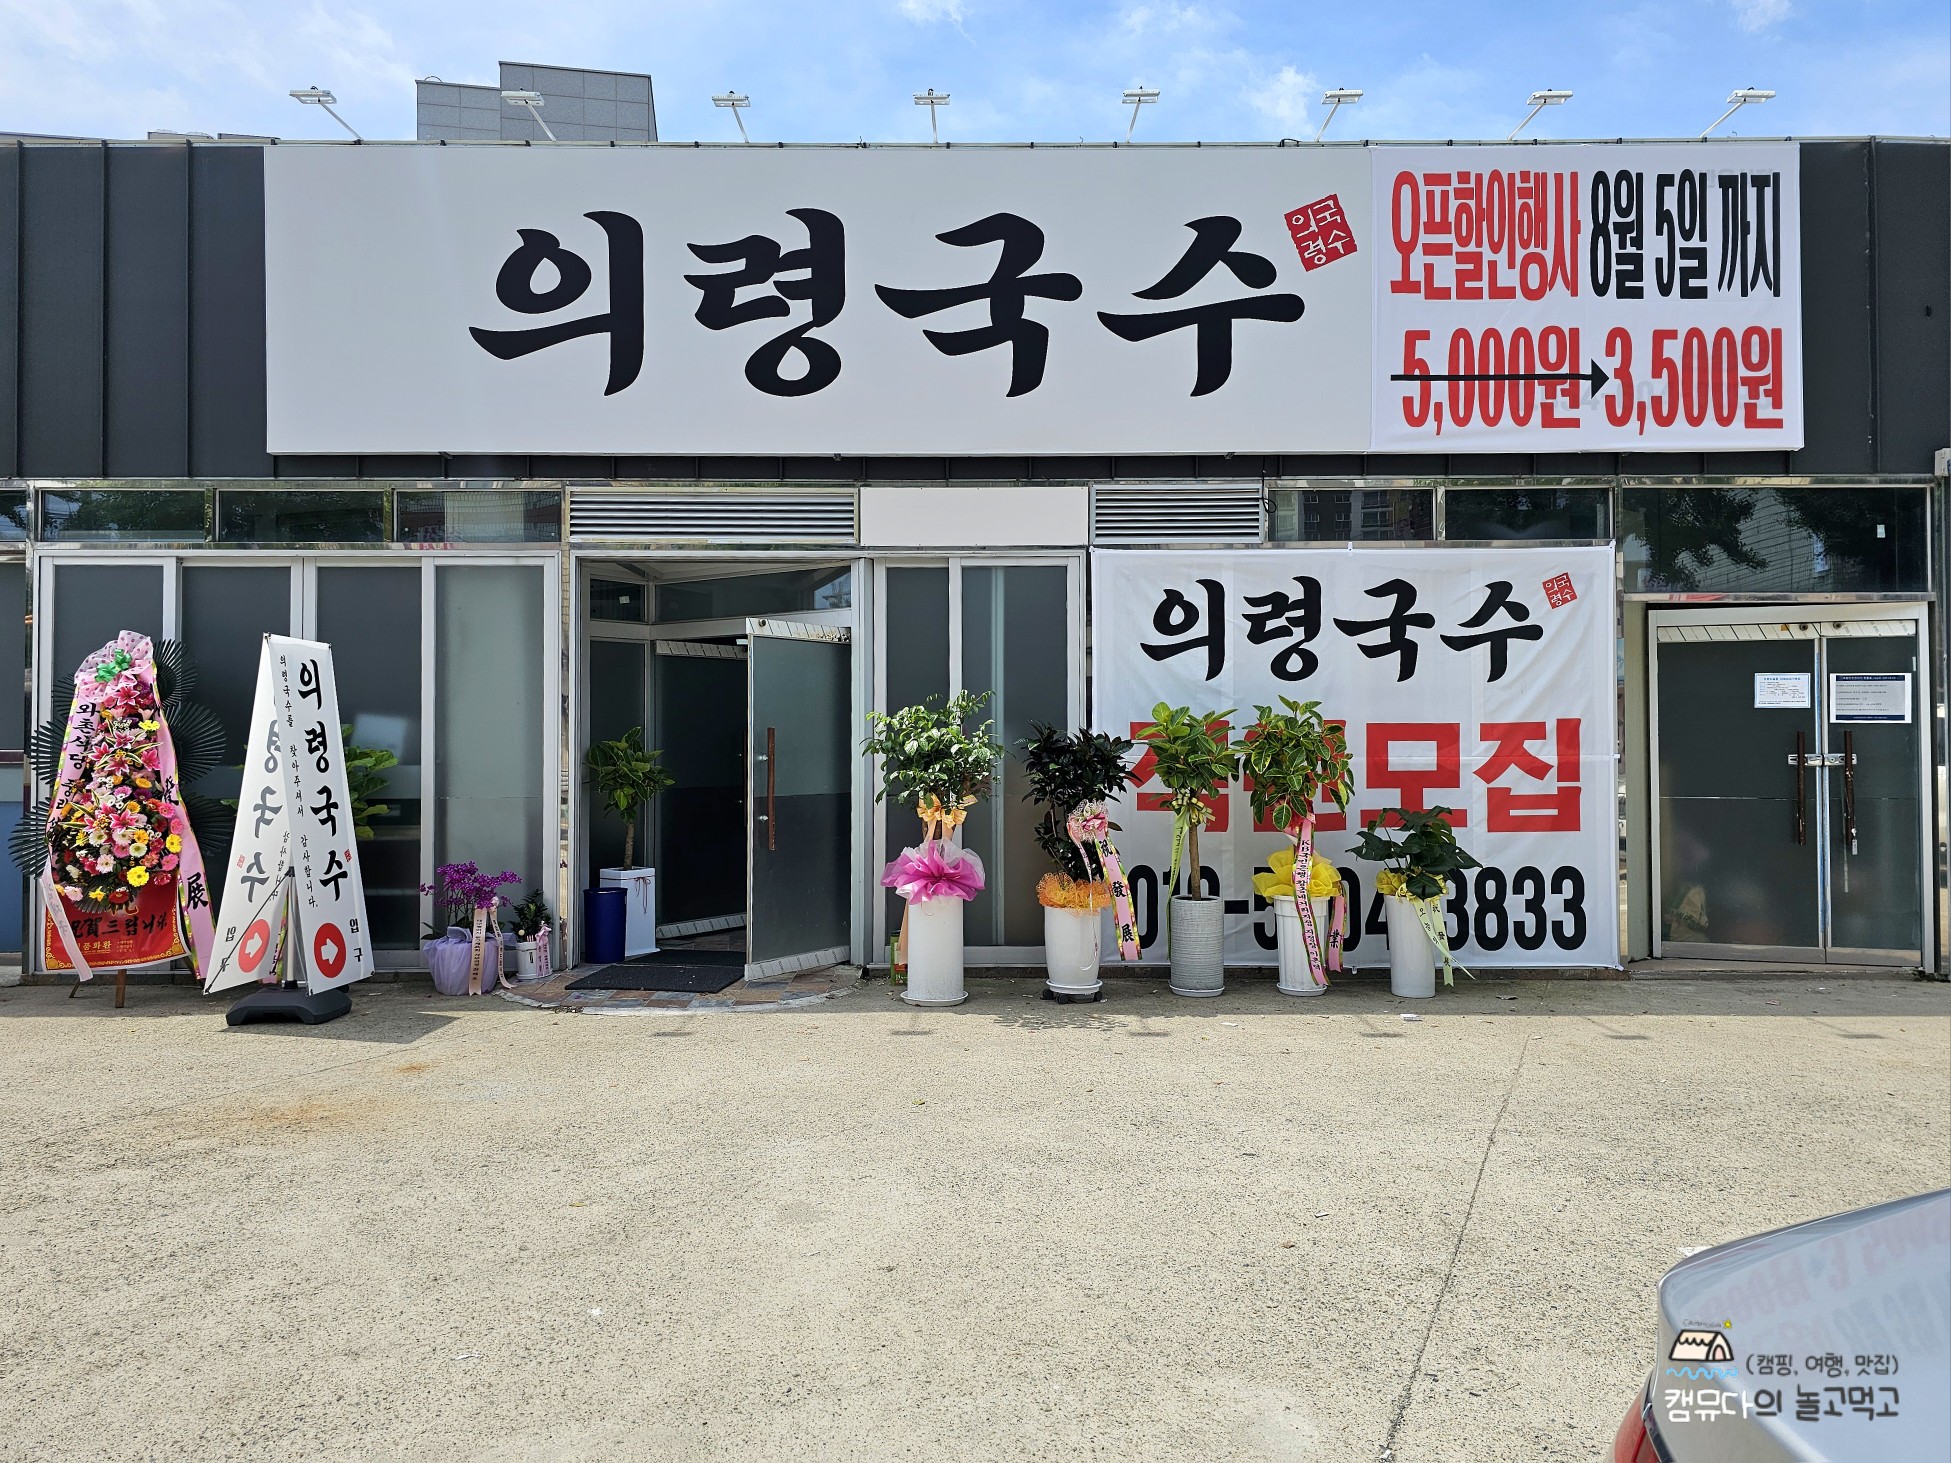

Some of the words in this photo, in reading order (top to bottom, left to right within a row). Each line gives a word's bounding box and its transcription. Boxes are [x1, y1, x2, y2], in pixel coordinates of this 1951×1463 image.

[1391, 169, 1581, 300] 오픈할인행사
[1590, 169, 1644, 299] 8월
[1655, 169, 1708, 299] 5일
[1718, 171, 1781, 297] 까지
[469, 204, 1304, 398] 의령국수
[1402, 326, 1580, 435] 5,000원
[1604, 325, 1784, 435] 3,500원
[1140, 575, 1544, 682] 의령국수
[279, 654, 294, 727] 의령국수를
[289, 743, 304, 818] 찾아주셔서
[300, 836, 318, 907] 감사합니다.
[297, 658, 350, 902] 의령국수
[349, 918, 363, 963] 입구
